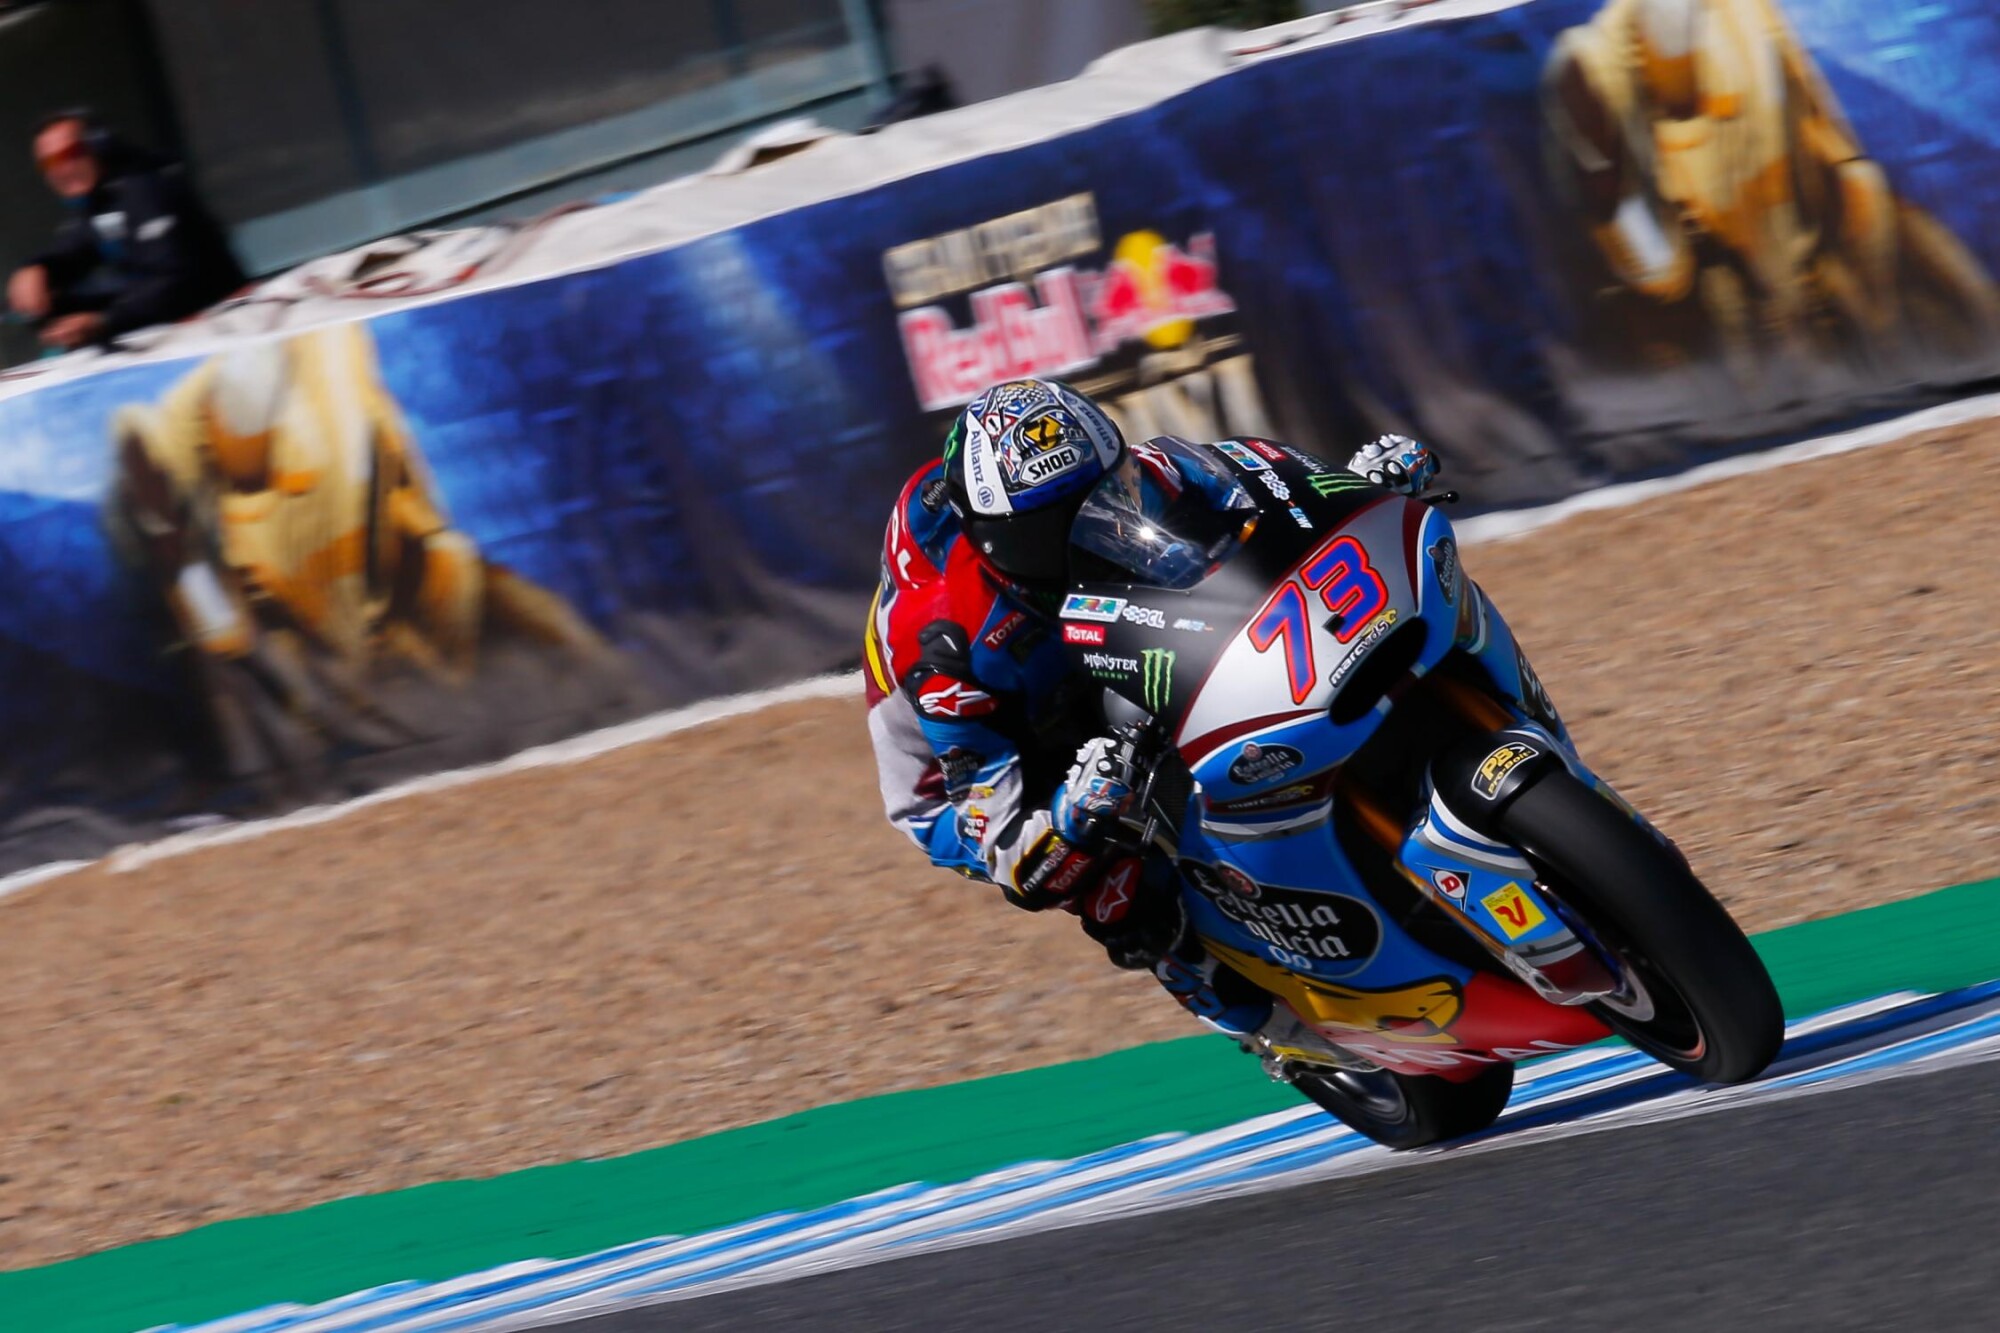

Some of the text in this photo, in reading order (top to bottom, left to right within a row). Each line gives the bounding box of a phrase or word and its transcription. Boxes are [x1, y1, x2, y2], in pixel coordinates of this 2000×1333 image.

[970, 429, 985, 485] Allianz
[1028, 449, 1076, 480] SHOEI
[984, 611, 1026, 646] TOTAL
[1065, 626, 1103, 643] TOTAL
[1247, 534, 1389, 706] 73
[1083, 653, 1139, 674] MONSTER
[1480, 747, 1516, 782] PB
[1051, 857, 1090, 890] TOTAL
